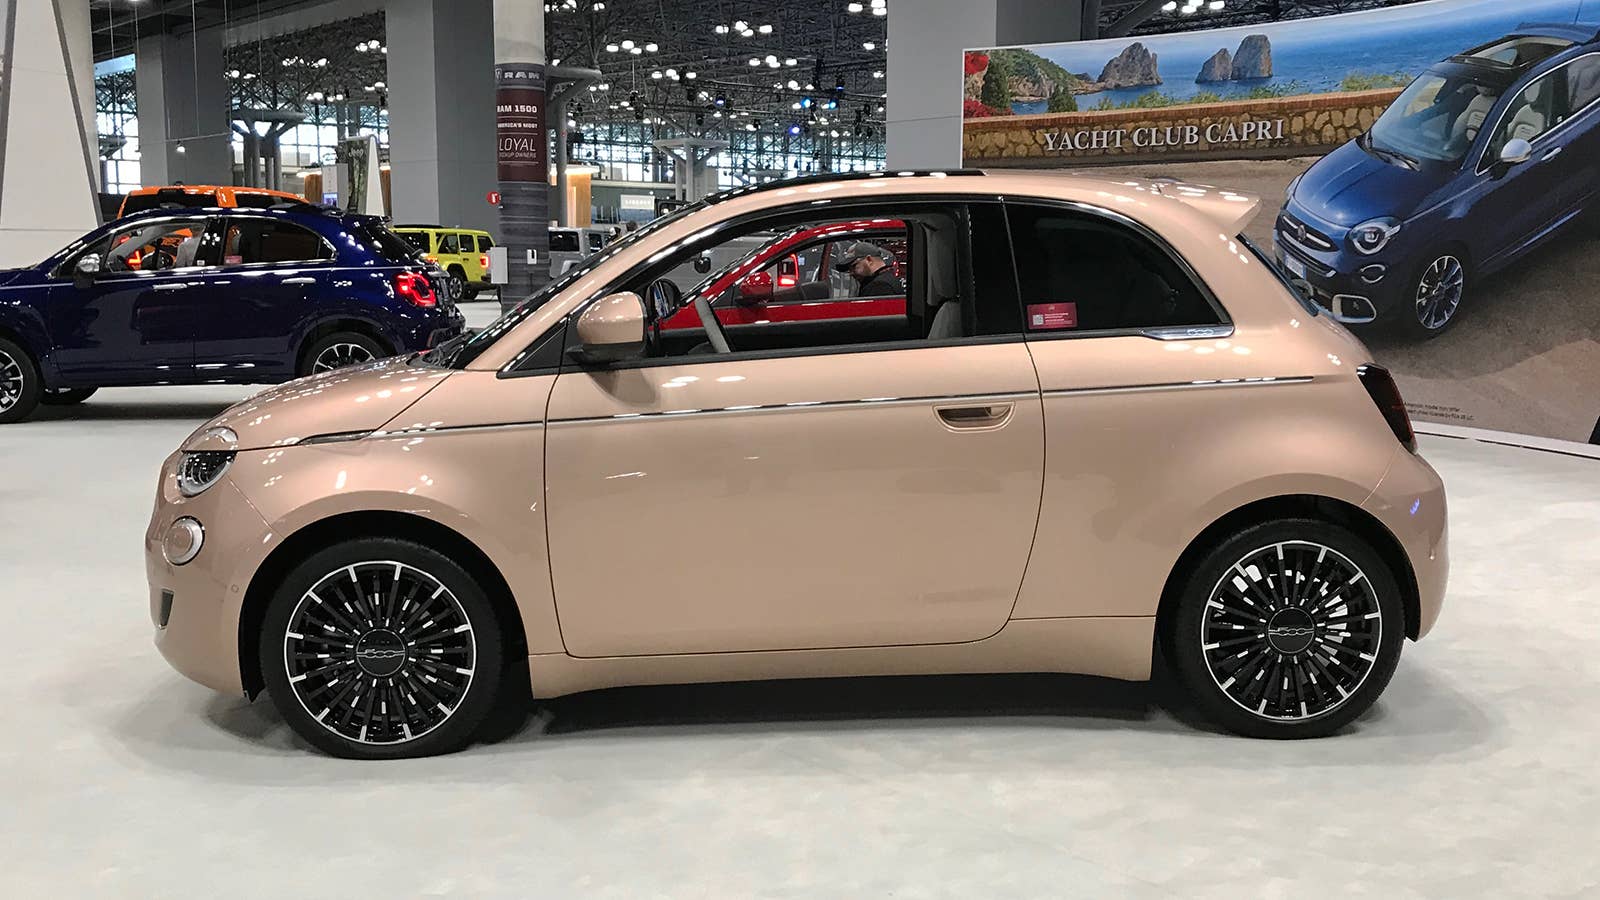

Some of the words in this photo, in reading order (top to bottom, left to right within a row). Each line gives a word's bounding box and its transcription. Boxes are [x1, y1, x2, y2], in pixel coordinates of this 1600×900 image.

[504, 71, 540, 80] RAM
[514, 104, 538, 113] 1500
[1044, 129, 1127, 151] YACHT
[1132, 125, 1199, 147] CLUB
[1205, 119, 1285, 143] CAPRI
[499, 137, 537, 152] LOYAL
